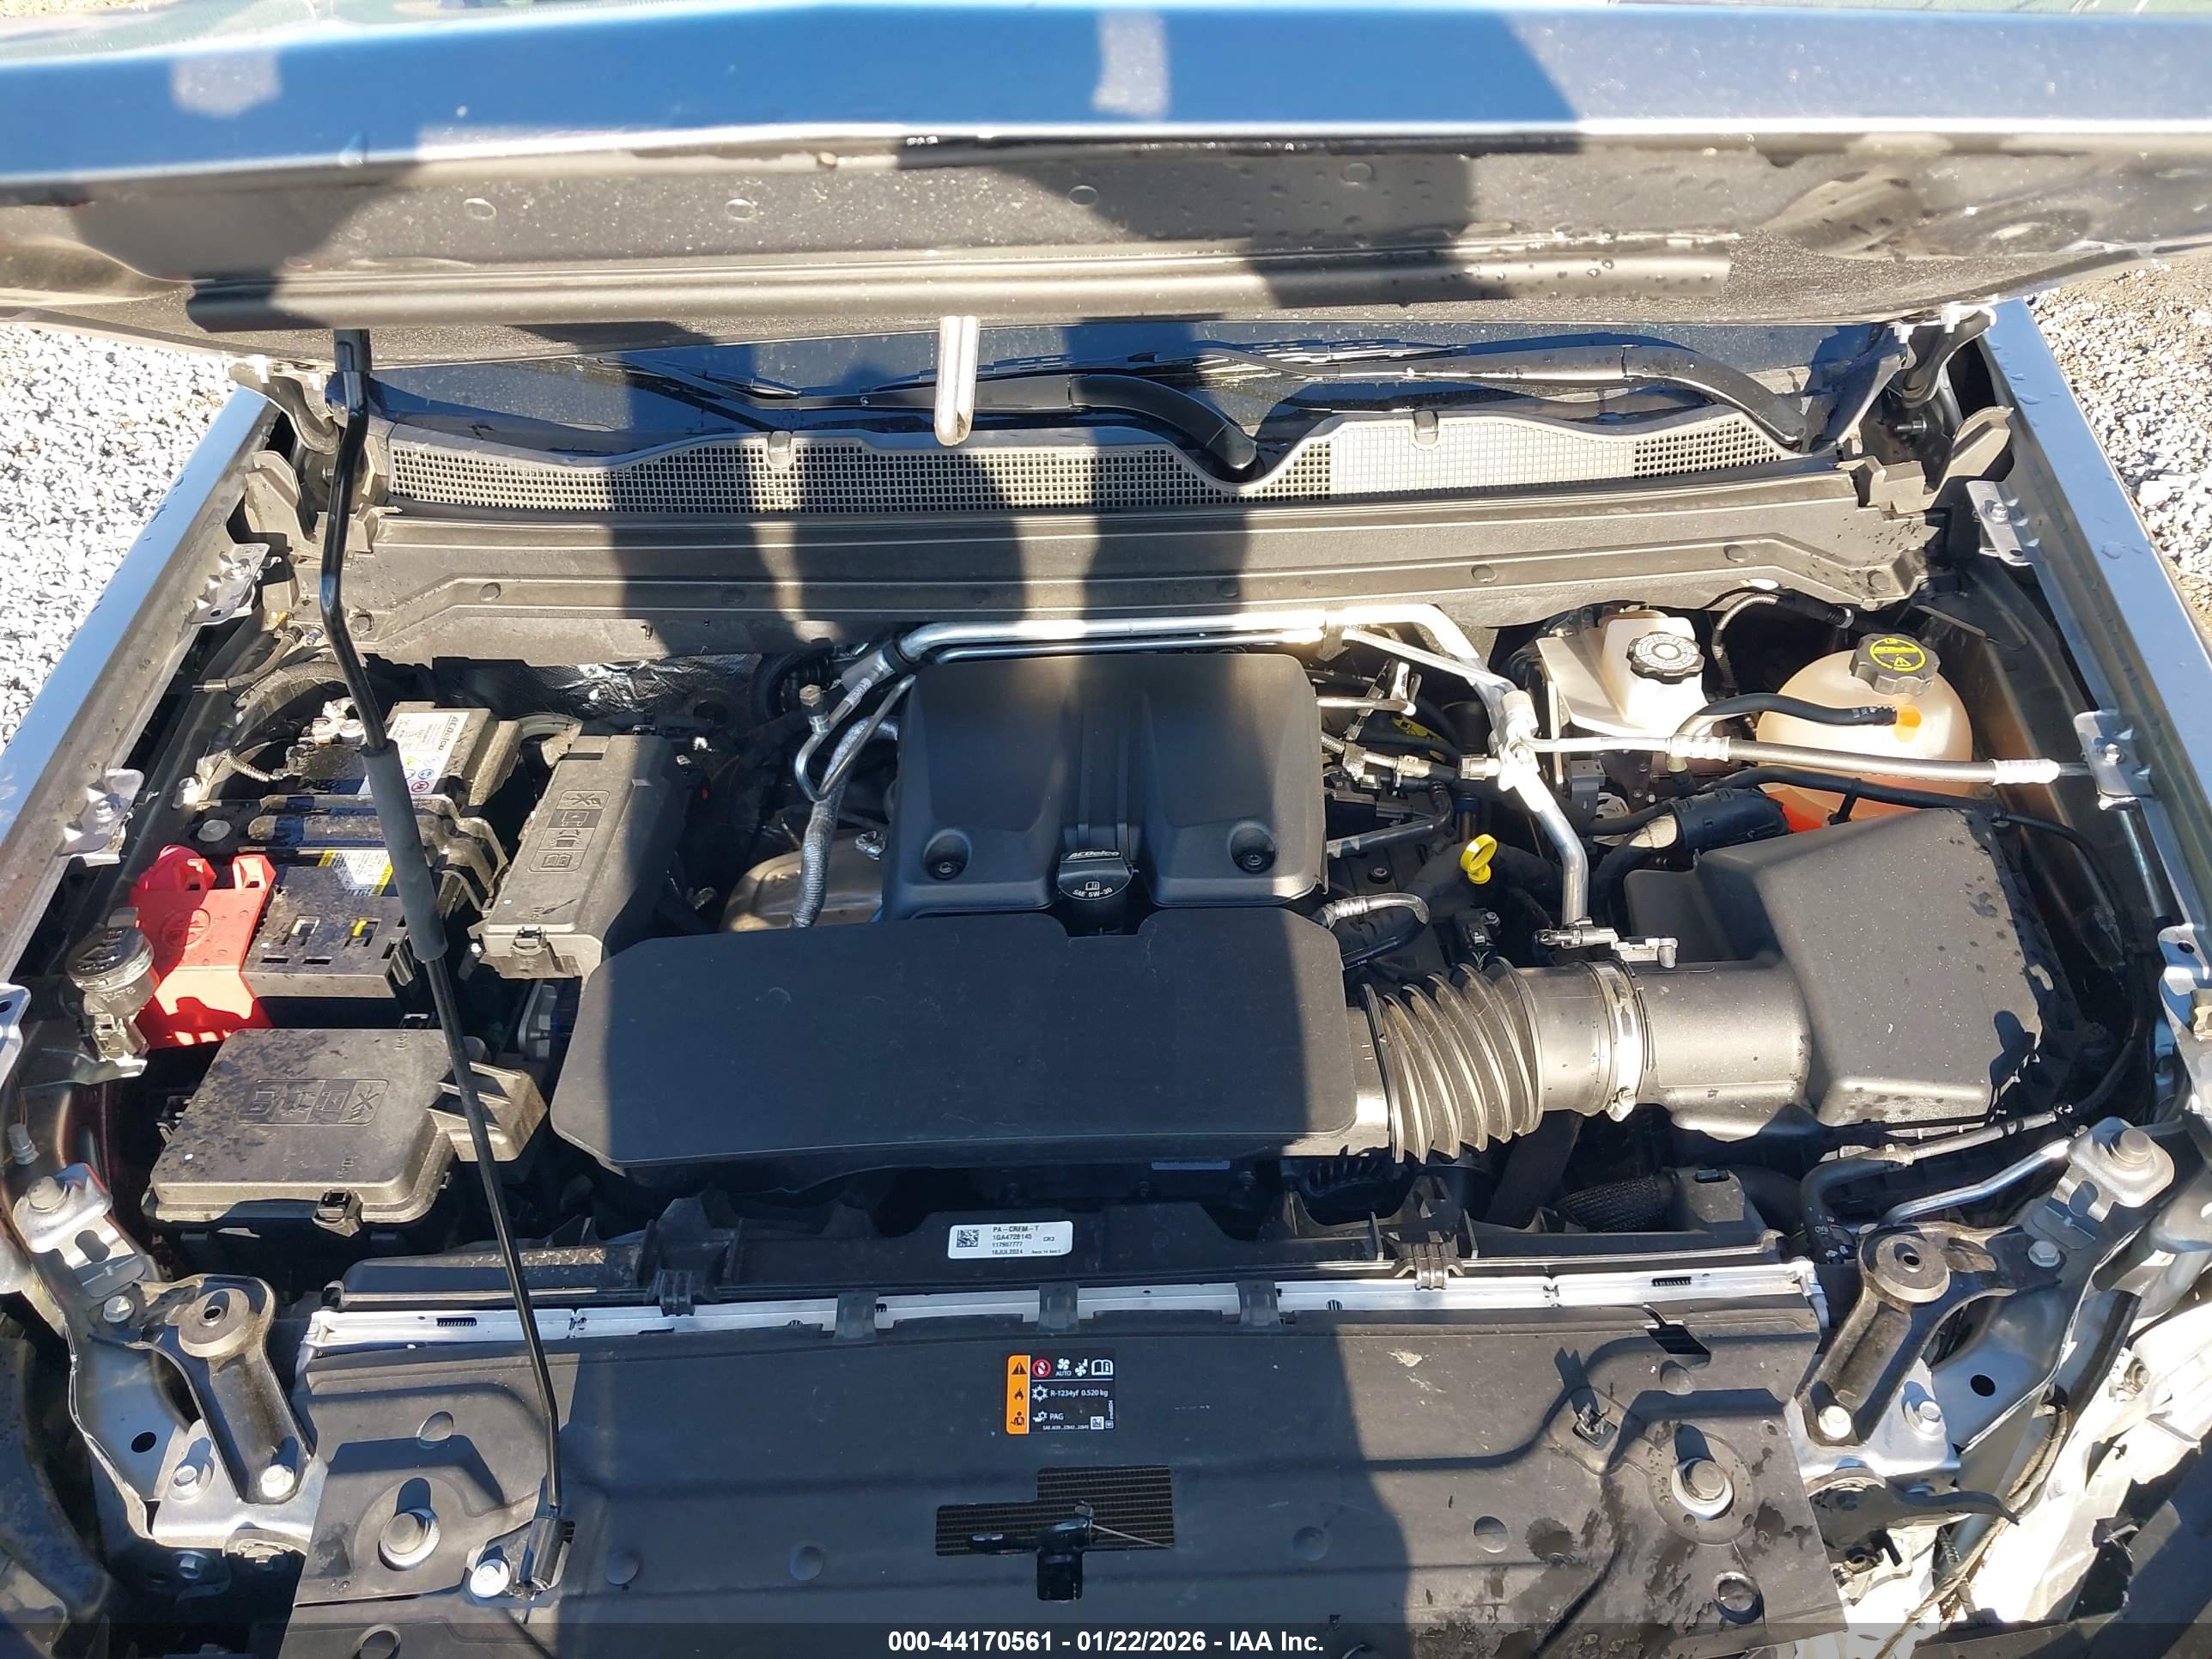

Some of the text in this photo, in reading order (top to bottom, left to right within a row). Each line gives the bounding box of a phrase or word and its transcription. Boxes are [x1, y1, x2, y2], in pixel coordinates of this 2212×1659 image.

[1073, 886, 1113, 897] SAE 5W-30
[1050, 1389, 1079, 1398] R-1234yf
